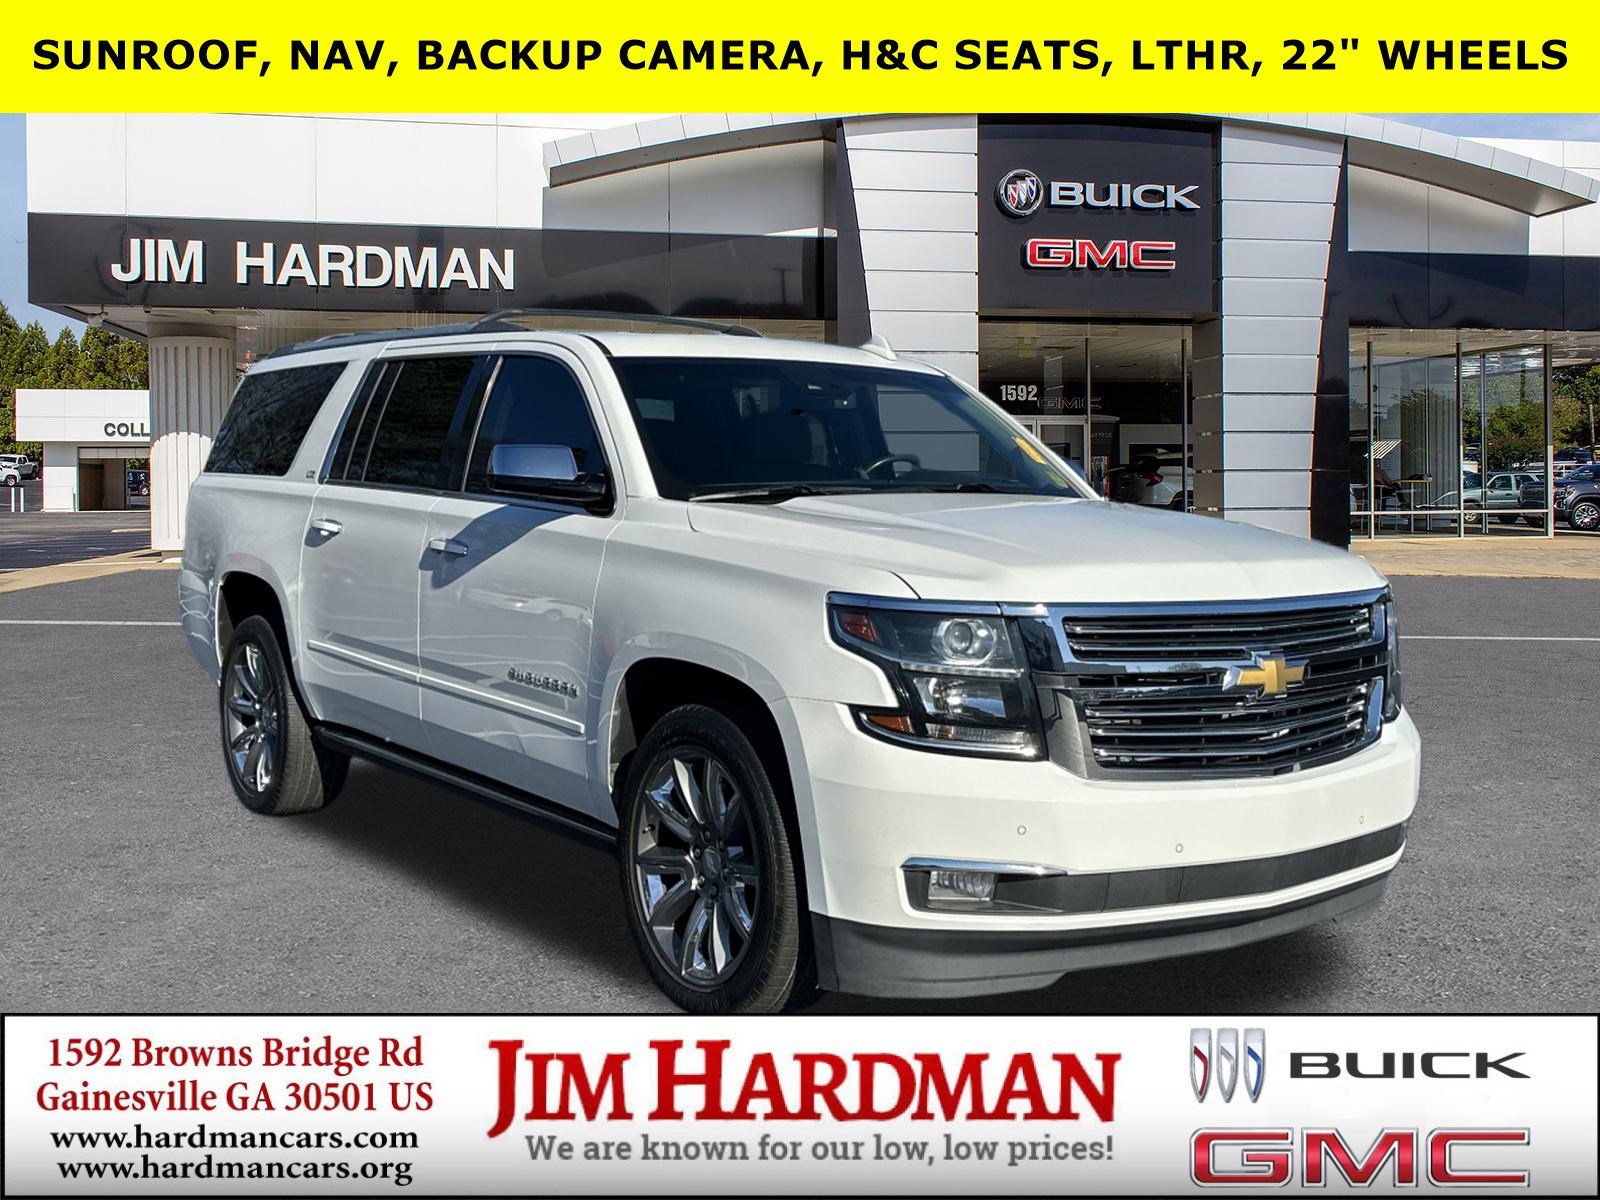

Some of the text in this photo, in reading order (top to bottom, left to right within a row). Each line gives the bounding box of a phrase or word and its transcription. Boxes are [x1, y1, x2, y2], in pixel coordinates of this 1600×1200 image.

[1050, 181, 1200, 209] BUICK
[111, 238, 515, 291] JIM HARDMAN
[1027, 238, 1176, 270] GMC
[1000, 384, 1038, 401] 1592
[1037, 396, 1102, 409] GMC
